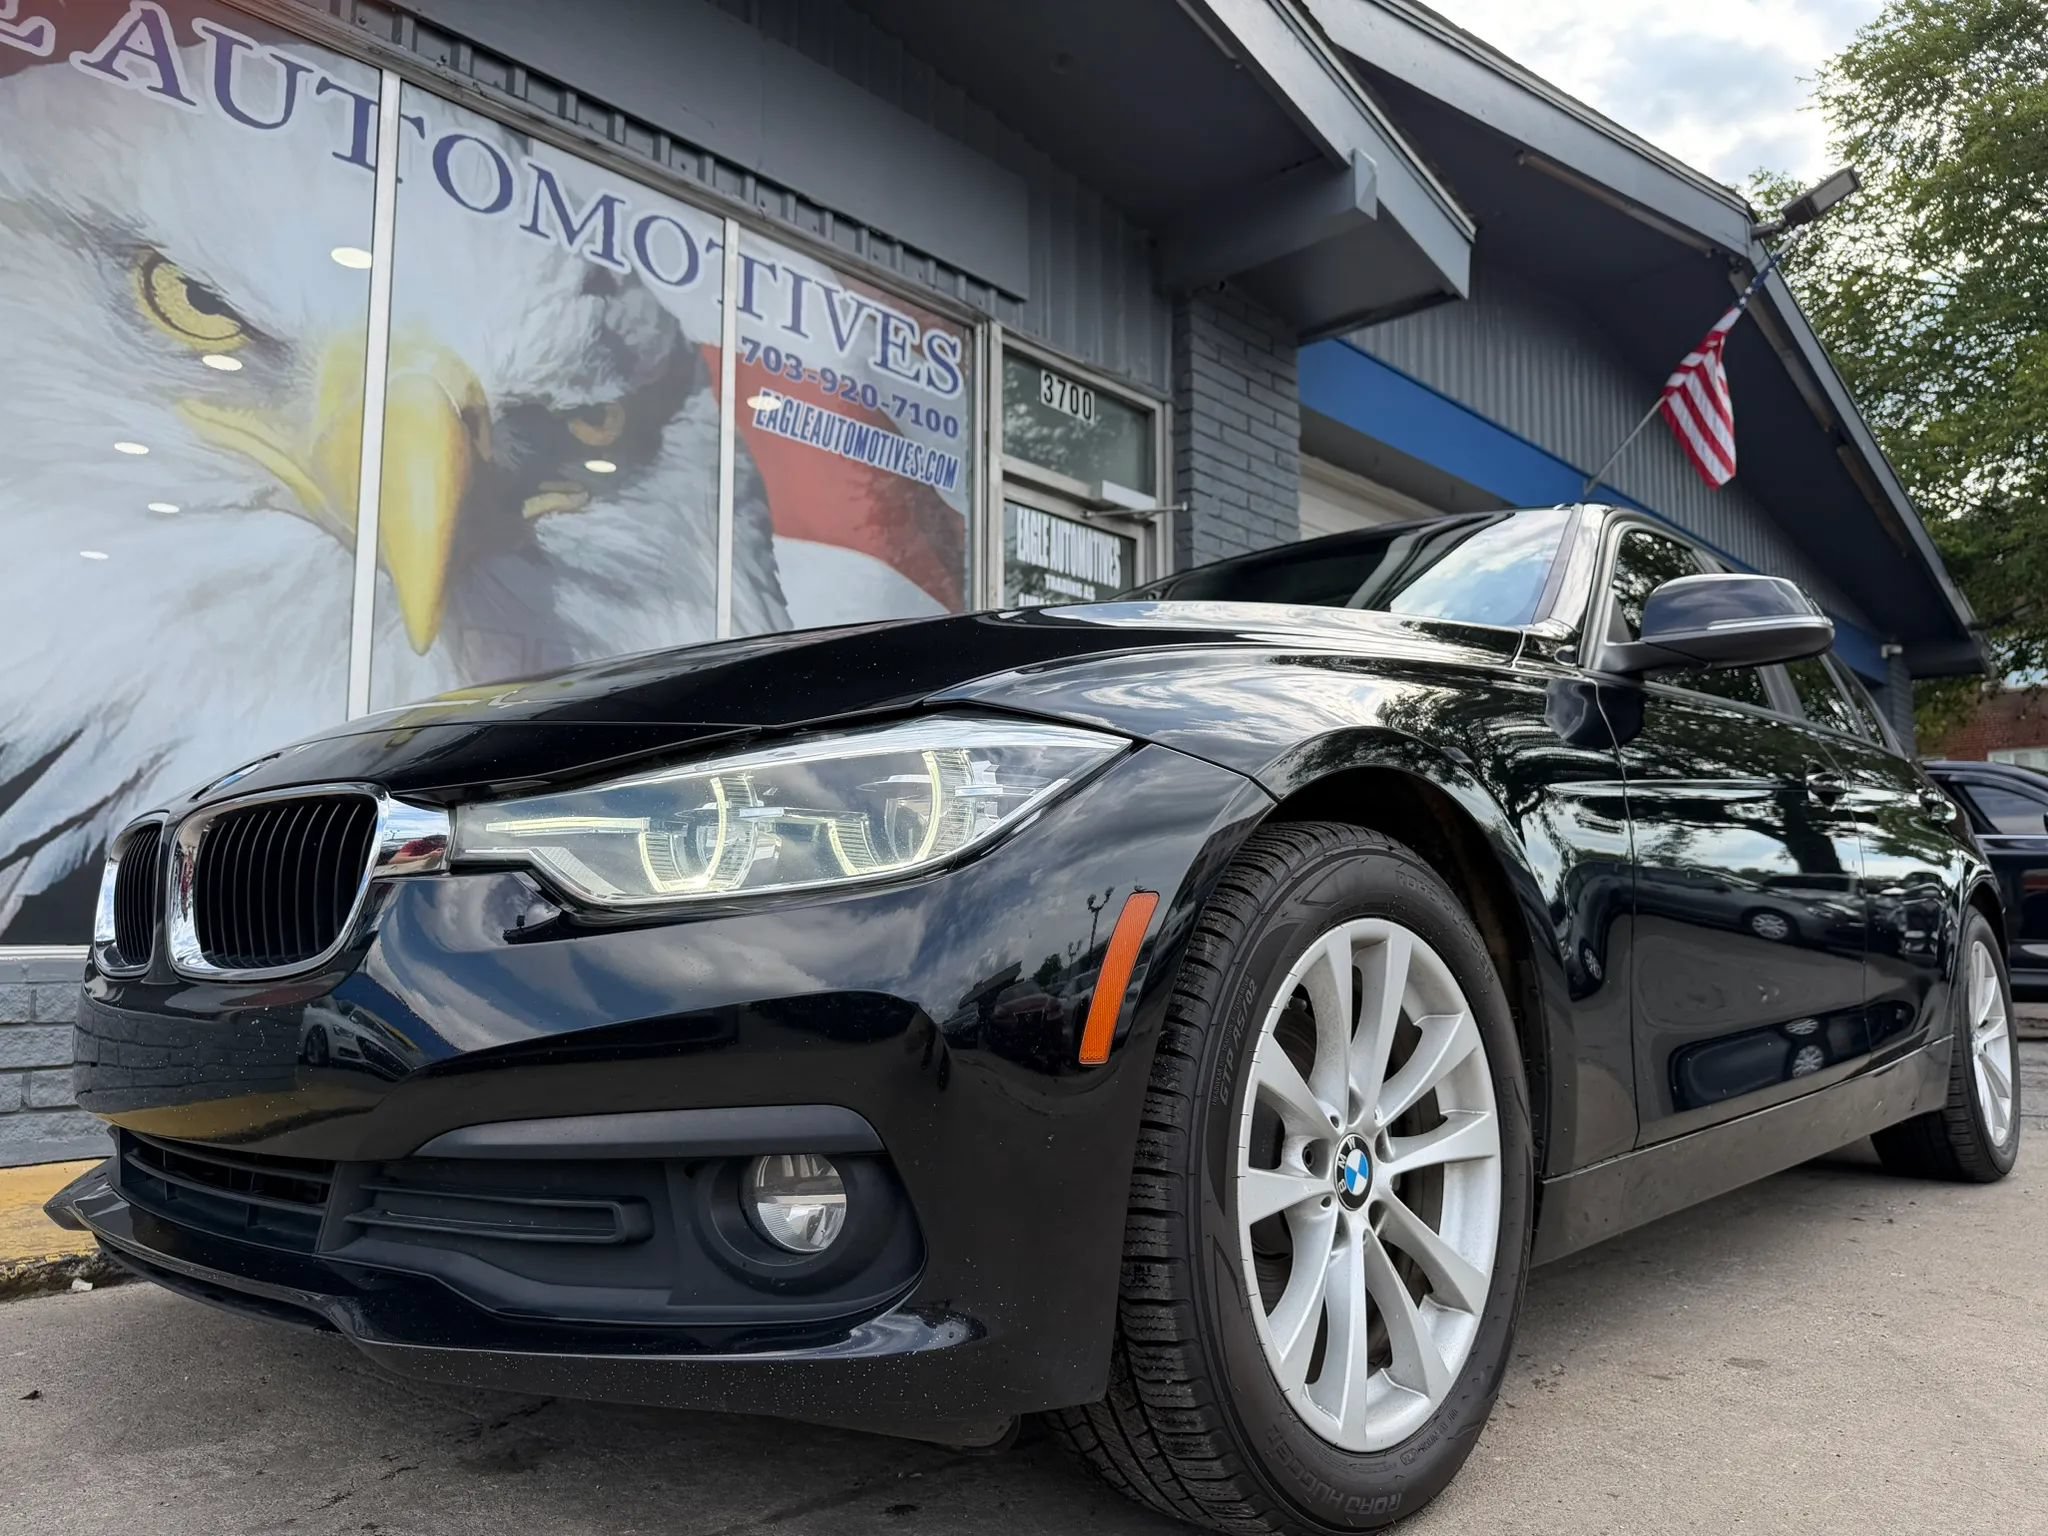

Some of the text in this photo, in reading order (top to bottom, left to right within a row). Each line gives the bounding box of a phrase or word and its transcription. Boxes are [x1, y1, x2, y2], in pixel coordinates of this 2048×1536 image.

[76, 4, 964, 397] AUTOMOTIVES
[741, 336, 959, 438] 703-920-7100
[1044, 374, 1092, 420] 3700
[1220, 1047, 1234, 1106] GTP
[1337, 1136, 1356, 1193] BMW
